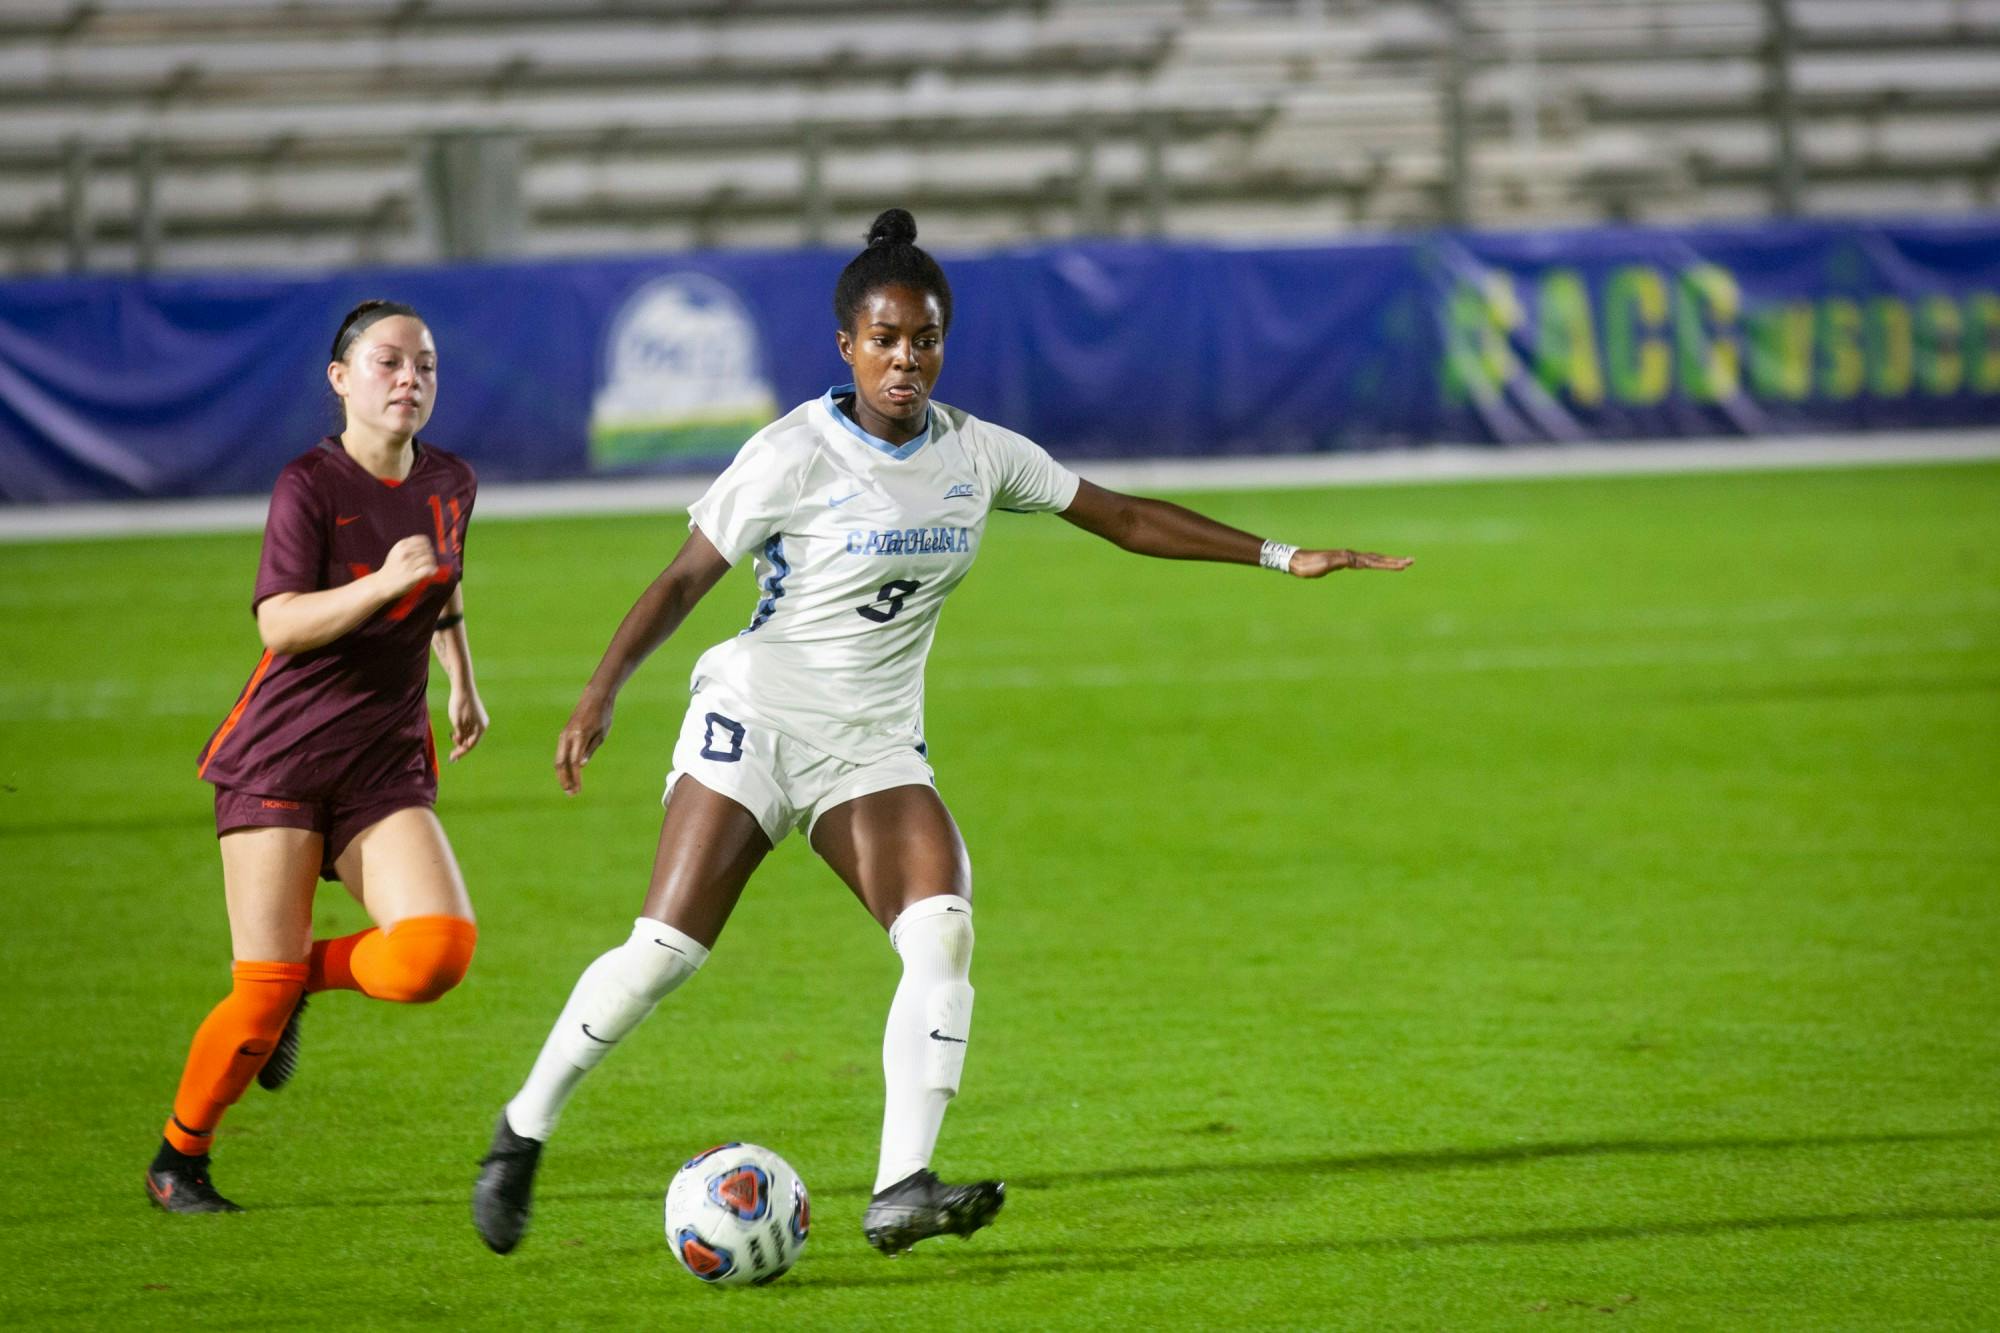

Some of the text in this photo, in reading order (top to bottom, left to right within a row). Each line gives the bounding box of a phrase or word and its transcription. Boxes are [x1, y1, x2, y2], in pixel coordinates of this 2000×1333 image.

[945, 484, 974, 497] ACC
[427, 495, 462, 555] 11
[846, 527, 969, 556] CAROLINA
[874, 528, 951, 553] Tar Heels
